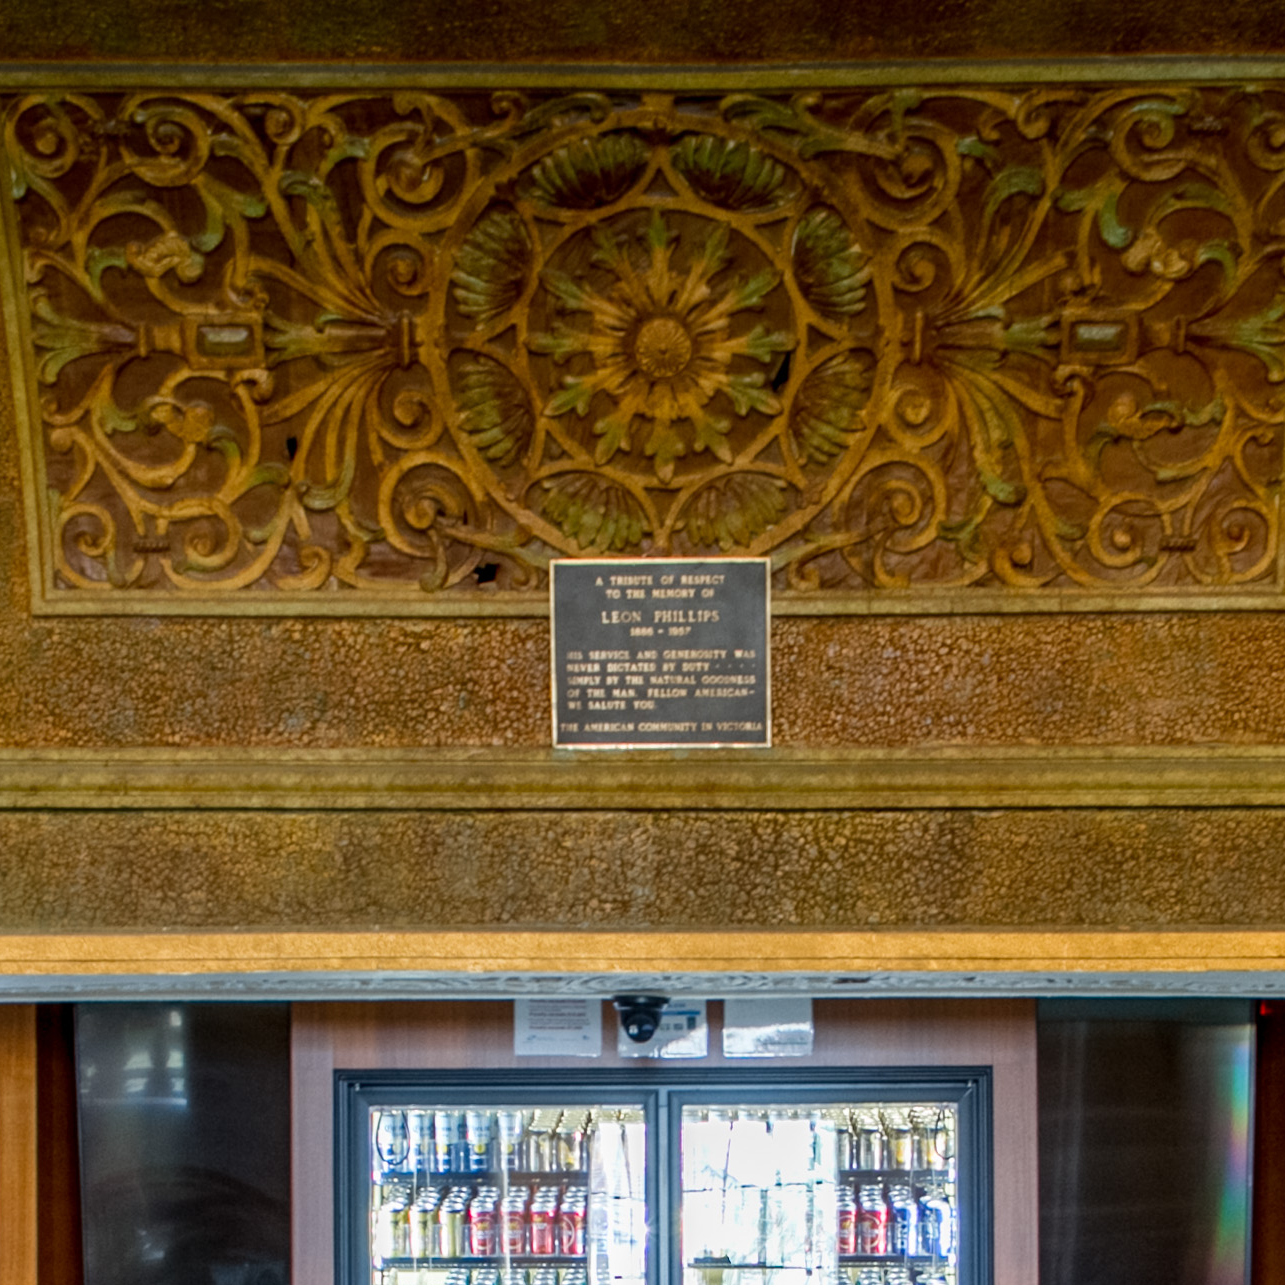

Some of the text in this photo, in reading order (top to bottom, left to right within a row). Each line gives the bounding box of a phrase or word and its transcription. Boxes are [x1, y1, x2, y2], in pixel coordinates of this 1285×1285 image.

[595, 574, 725, 586] A TRIBUTE OF RESPECT
[605, 588, 714, 599] TO THE MEMORY OF
[601, 610, 720, 624] LEON PHILLIPS
[567, 649, 756, 660] HIS SERVICE AND GENEROSITY WAS
[566, 662, 710, 673] NEVER DICTATED BY DUTY
[567, 674, 756, 685] SIMPLY BY THE NATURAL GOODNESS
[567, 688, 580, 698] OF
[586, 688, 606, 698] THE
[647, 688, 688, 698] FELLOW
[567, 701, 582, 710] WE
[588, 701, 626, 710] SALUTE
[560, 722, 763, 732] THE AMERICAN COMMUNITY IN VICTORIA
